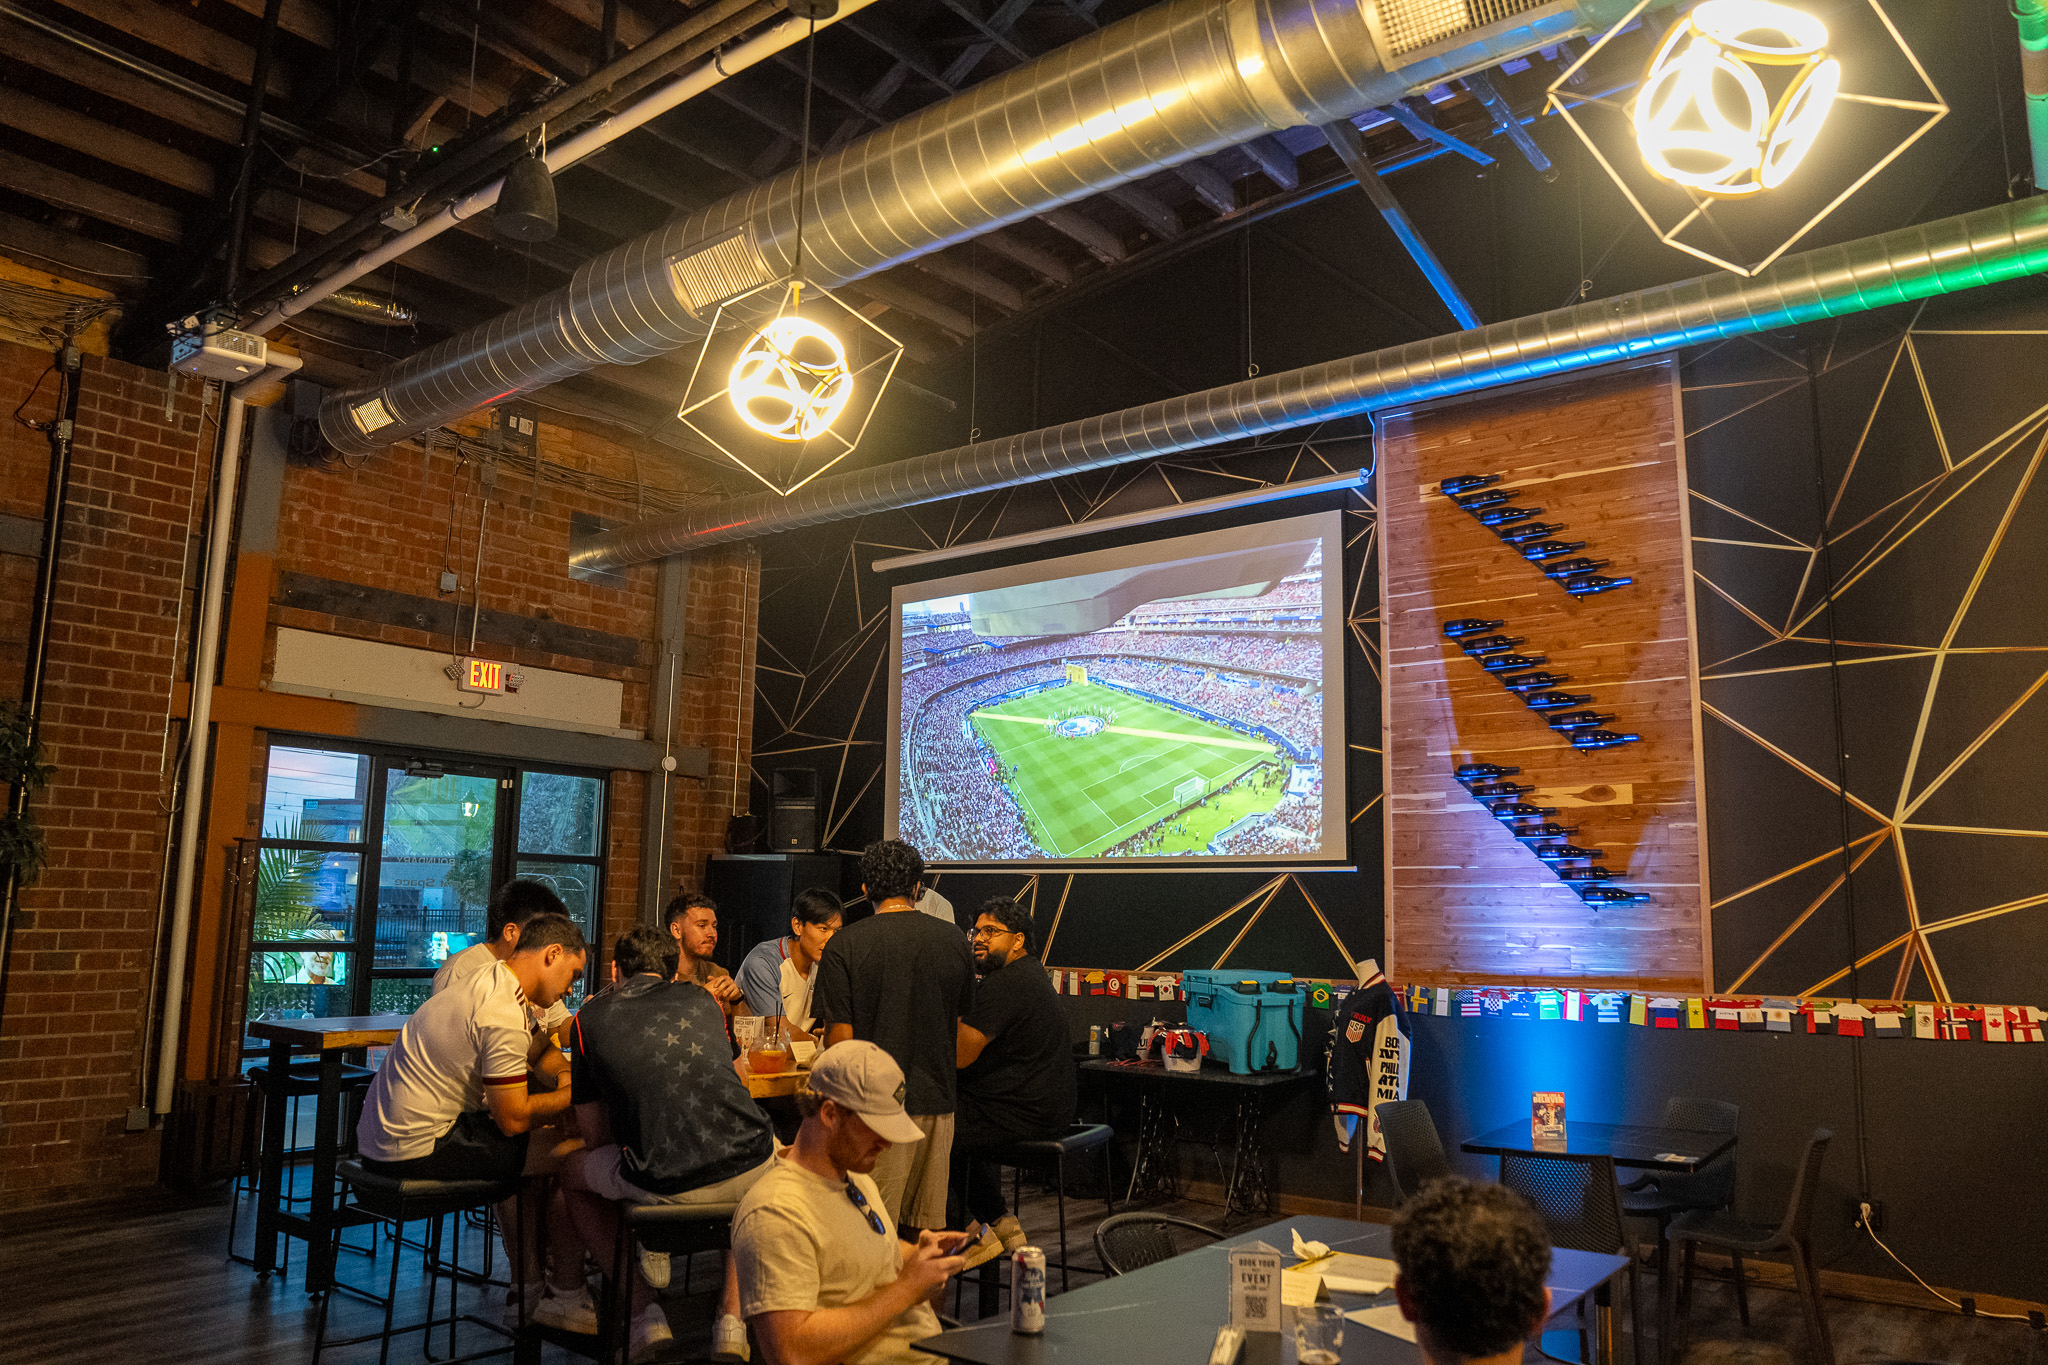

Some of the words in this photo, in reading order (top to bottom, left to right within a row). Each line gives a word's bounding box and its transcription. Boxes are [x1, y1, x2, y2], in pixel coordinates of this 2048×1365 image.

[470, 660, 502, 690] EXIT
[1351, 1011, 1372, 1023] TRULY
[1349, 1021, 1364, 1032] USA
[1239, 1258, 1256, 1267] BOOK
[1259, 1258, 1275, 1268] YOUR
[1242, 1272, 1270, 1285] EVENT
